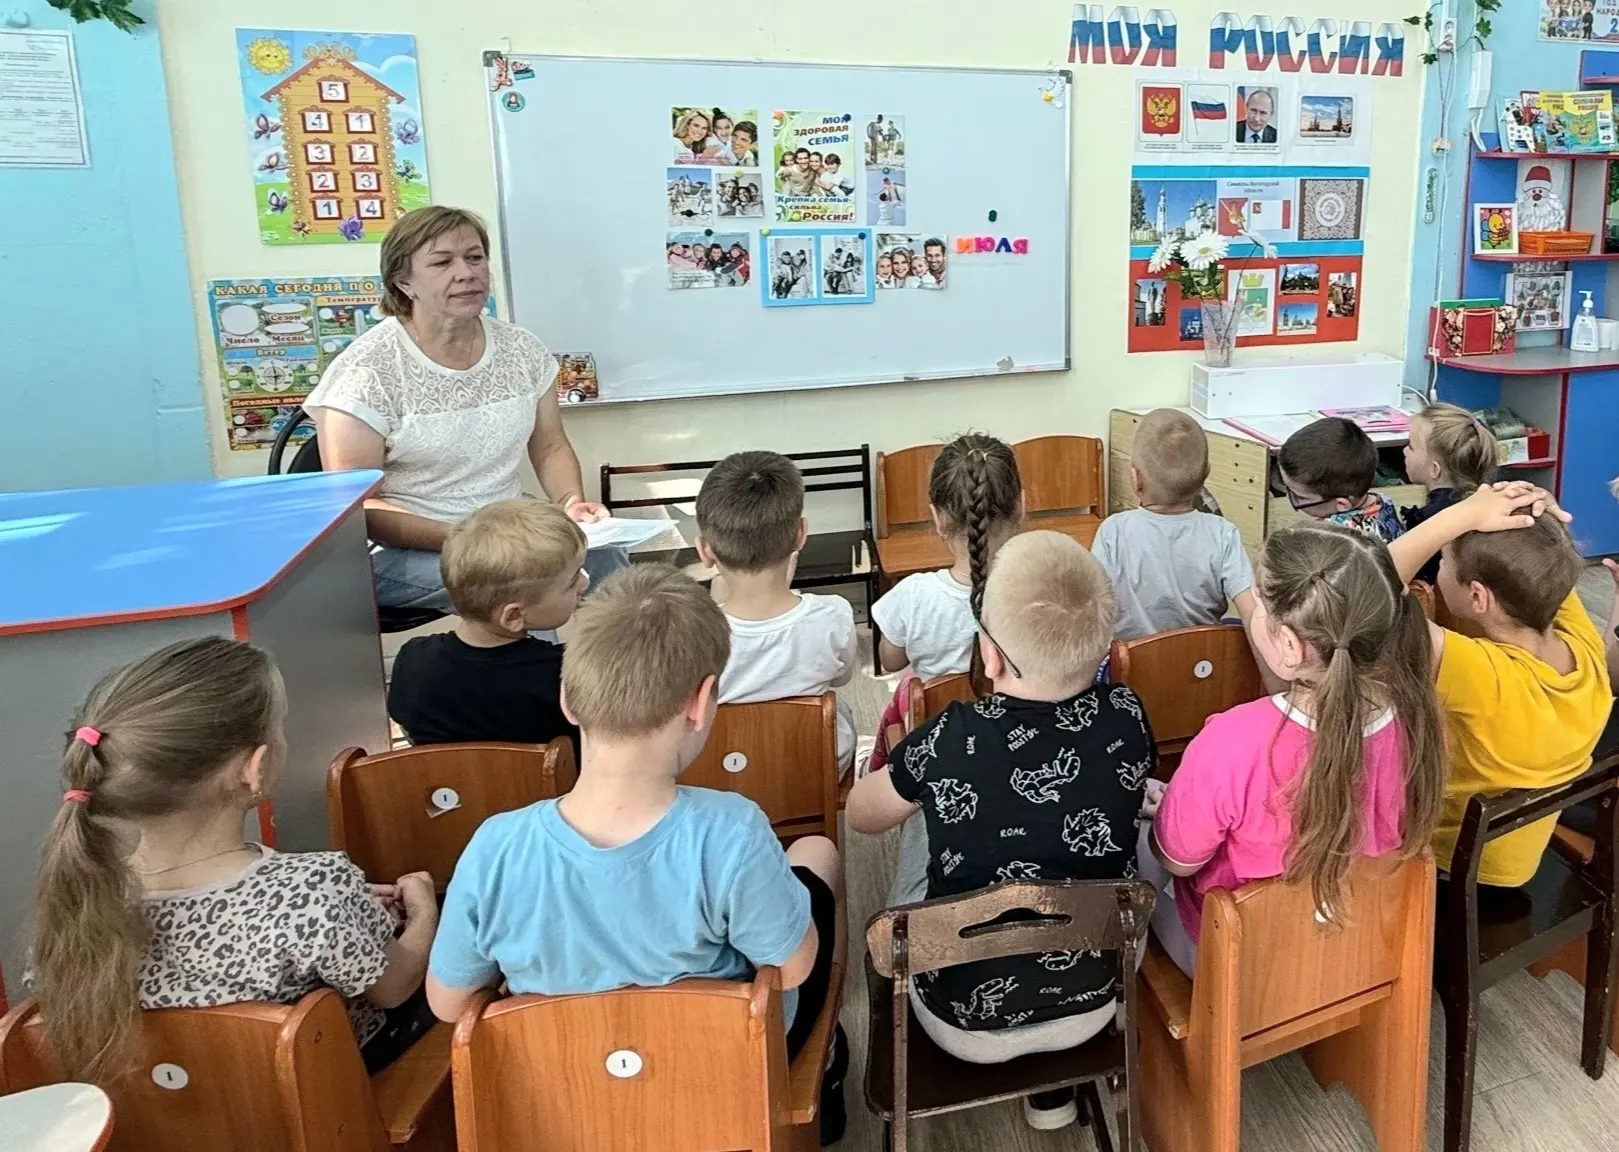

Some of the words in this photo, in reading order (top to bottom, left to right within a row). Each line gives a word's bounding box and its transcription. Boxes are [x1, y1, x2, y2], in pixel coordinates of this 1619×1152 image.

[1068, 4, 1177, 67] МОЯ
[1209, 12, 1405, 77] РОССИЯ
[327, 84, 340, 98] 5
[355, 114, 365, 129] 1
[794, 125, 849, 136] ЗДОРОВАЯ
[808, 135, 849, 146] СЕМЬЯ
[313, 146, 326, 161] 3
[358, 146, 369, 160] 2
[317, 174, 330, 188] 2
[360, 174, 373, 188] 3
[777, 196, 817, 204] Крепка
[323, 201, 332, 216] 1
[365, 201, 377, 215] 4
[803, 212, 854, 221] Россия!
[956, 236, 1029, 254] ИЮЛЯ
[215, 283, 268, 295] КАКАЯ
[275, 282, 342, 294] СЕГОДНЯ
[272, 335, 304, 343] Месяц
[1007, 724, 1026, 741] STAY
[1000, 828, 1027, 838] ROAR
